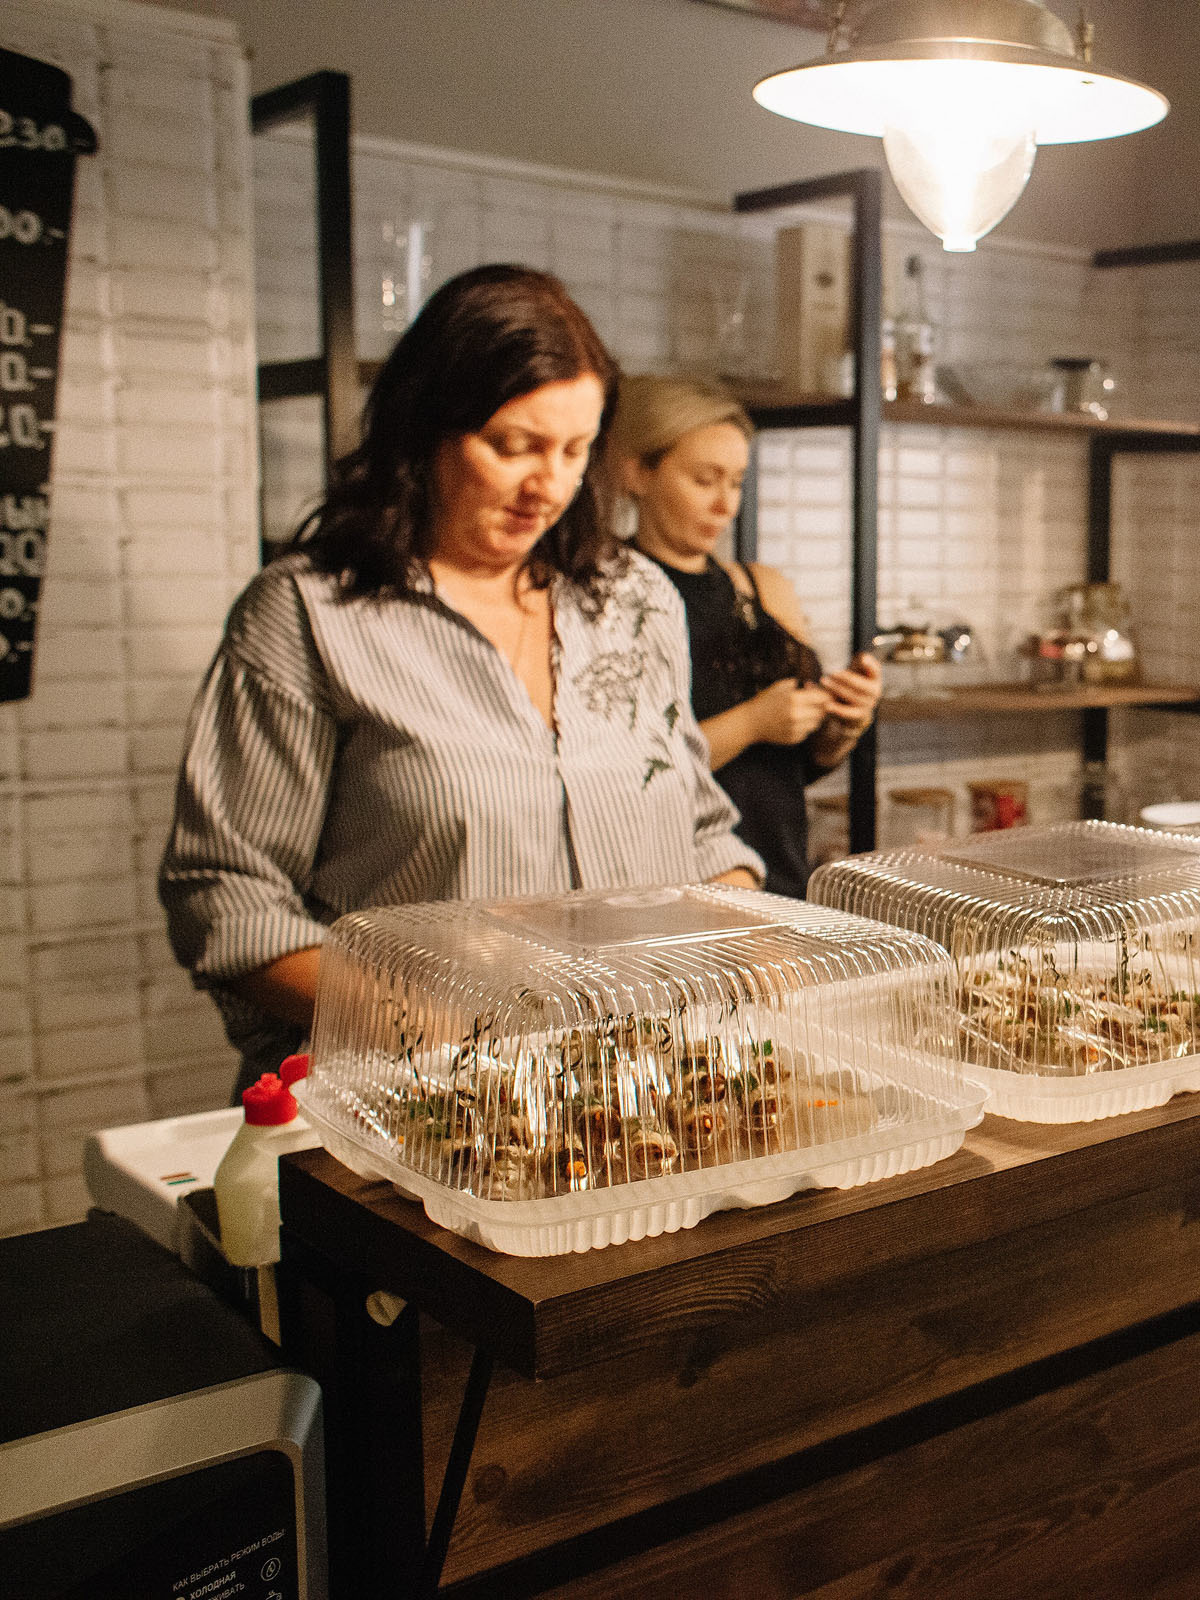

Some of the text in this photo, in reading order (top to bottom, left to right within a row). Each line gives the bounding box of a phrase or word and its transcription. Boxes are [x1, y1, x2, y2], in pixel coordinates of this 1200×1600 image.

[172, 1577, 189, 1592] КАК
[190, 1558, 230, 1583] ВЫБРАТЬ
[230, 1541, 261, 1562] РЕЖИМ
[189, 1570, 237, 1600] ХОЛОДНАЯ
